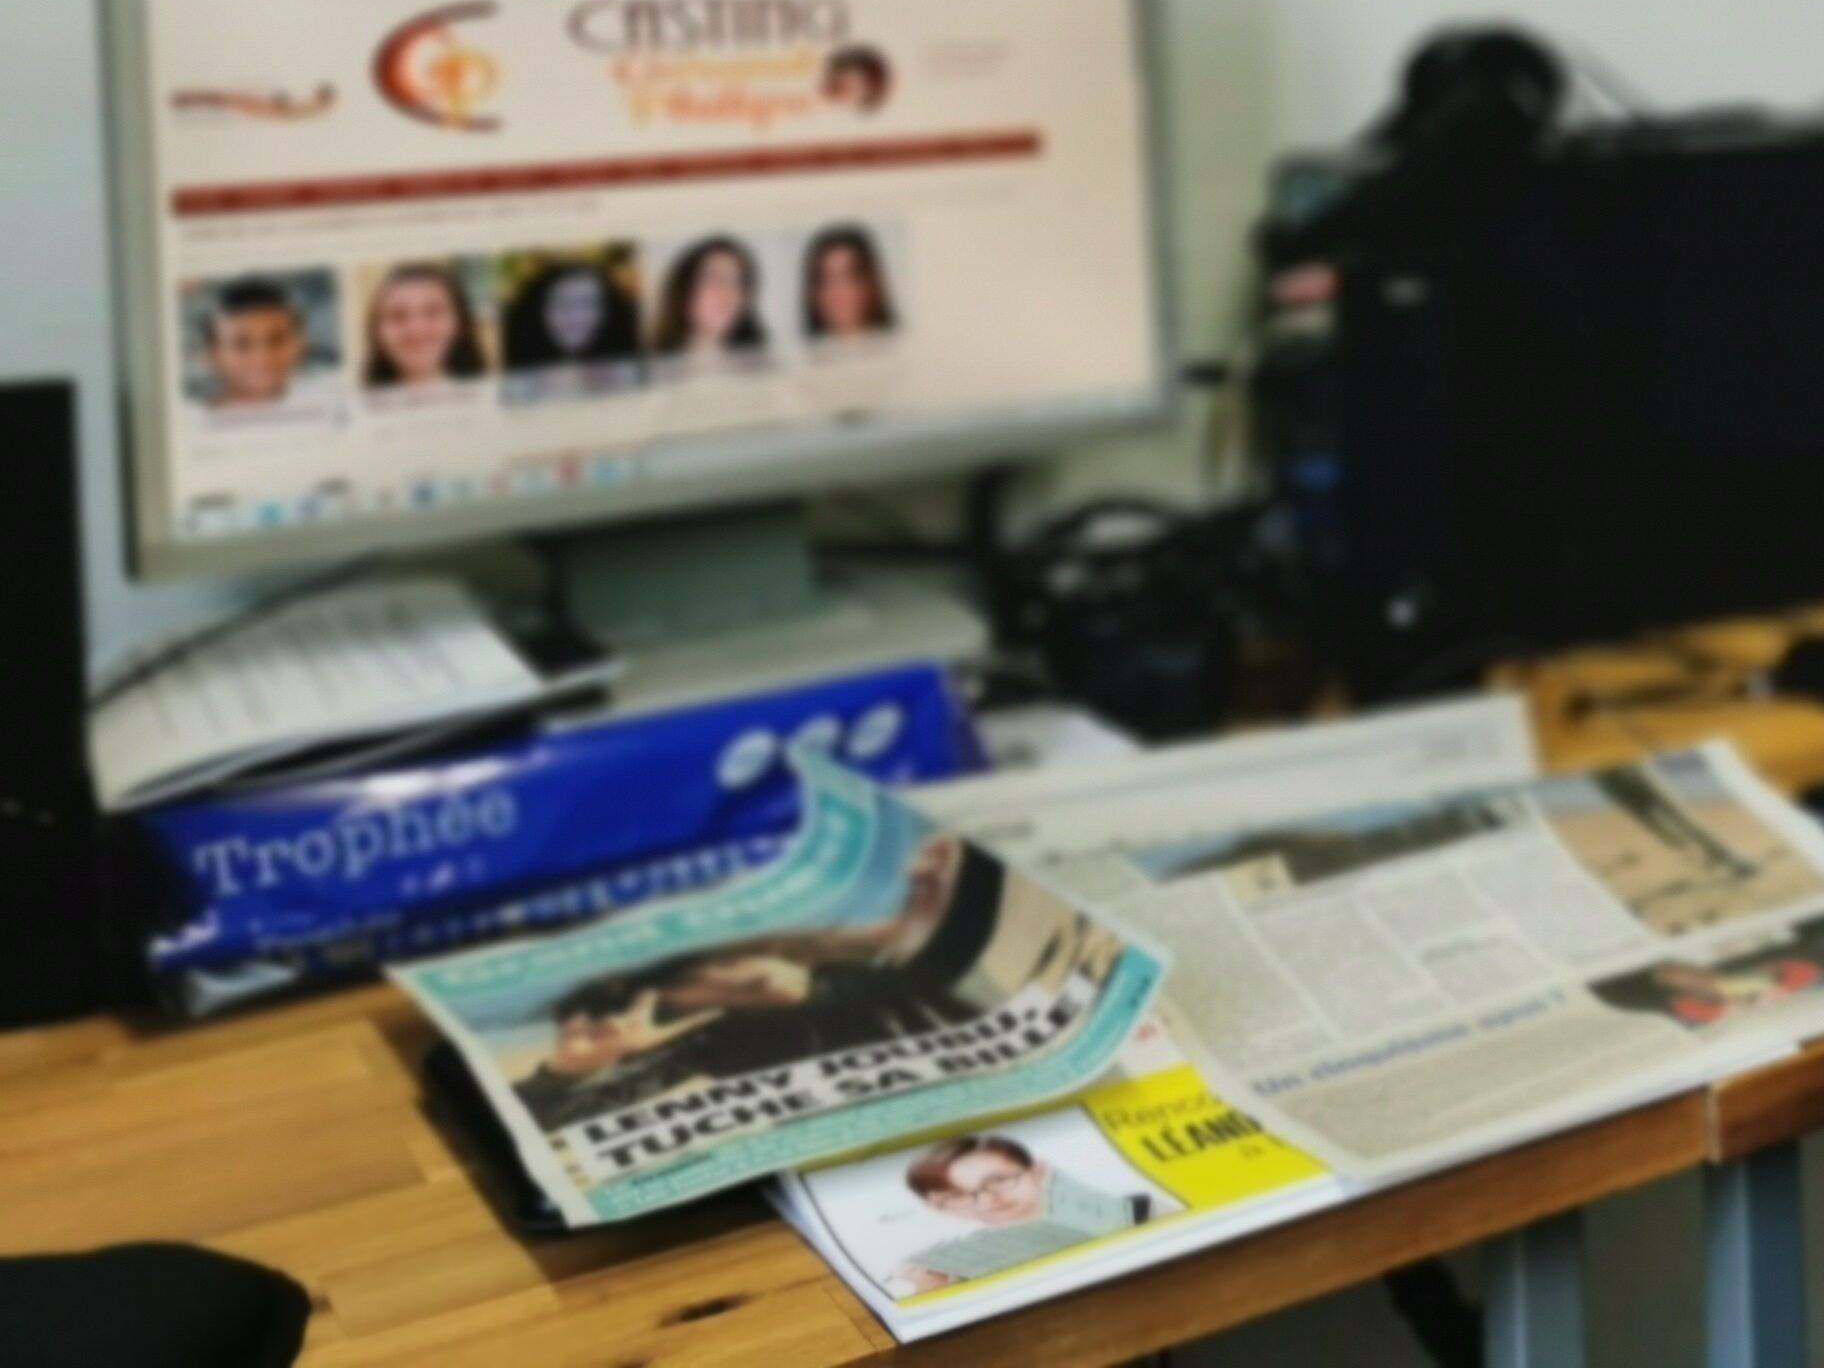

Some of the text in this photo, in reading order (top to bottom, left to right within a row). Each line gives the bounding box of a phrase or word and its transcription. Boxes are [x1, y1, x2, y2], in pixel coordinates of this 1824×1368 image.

[192, 786, 520, 898] Trophée
[584, 1066, 796, 1142] LENNY
[596, 1088, 816, 1170] TUCHE
[834, 1062, 920, 1096] SA
